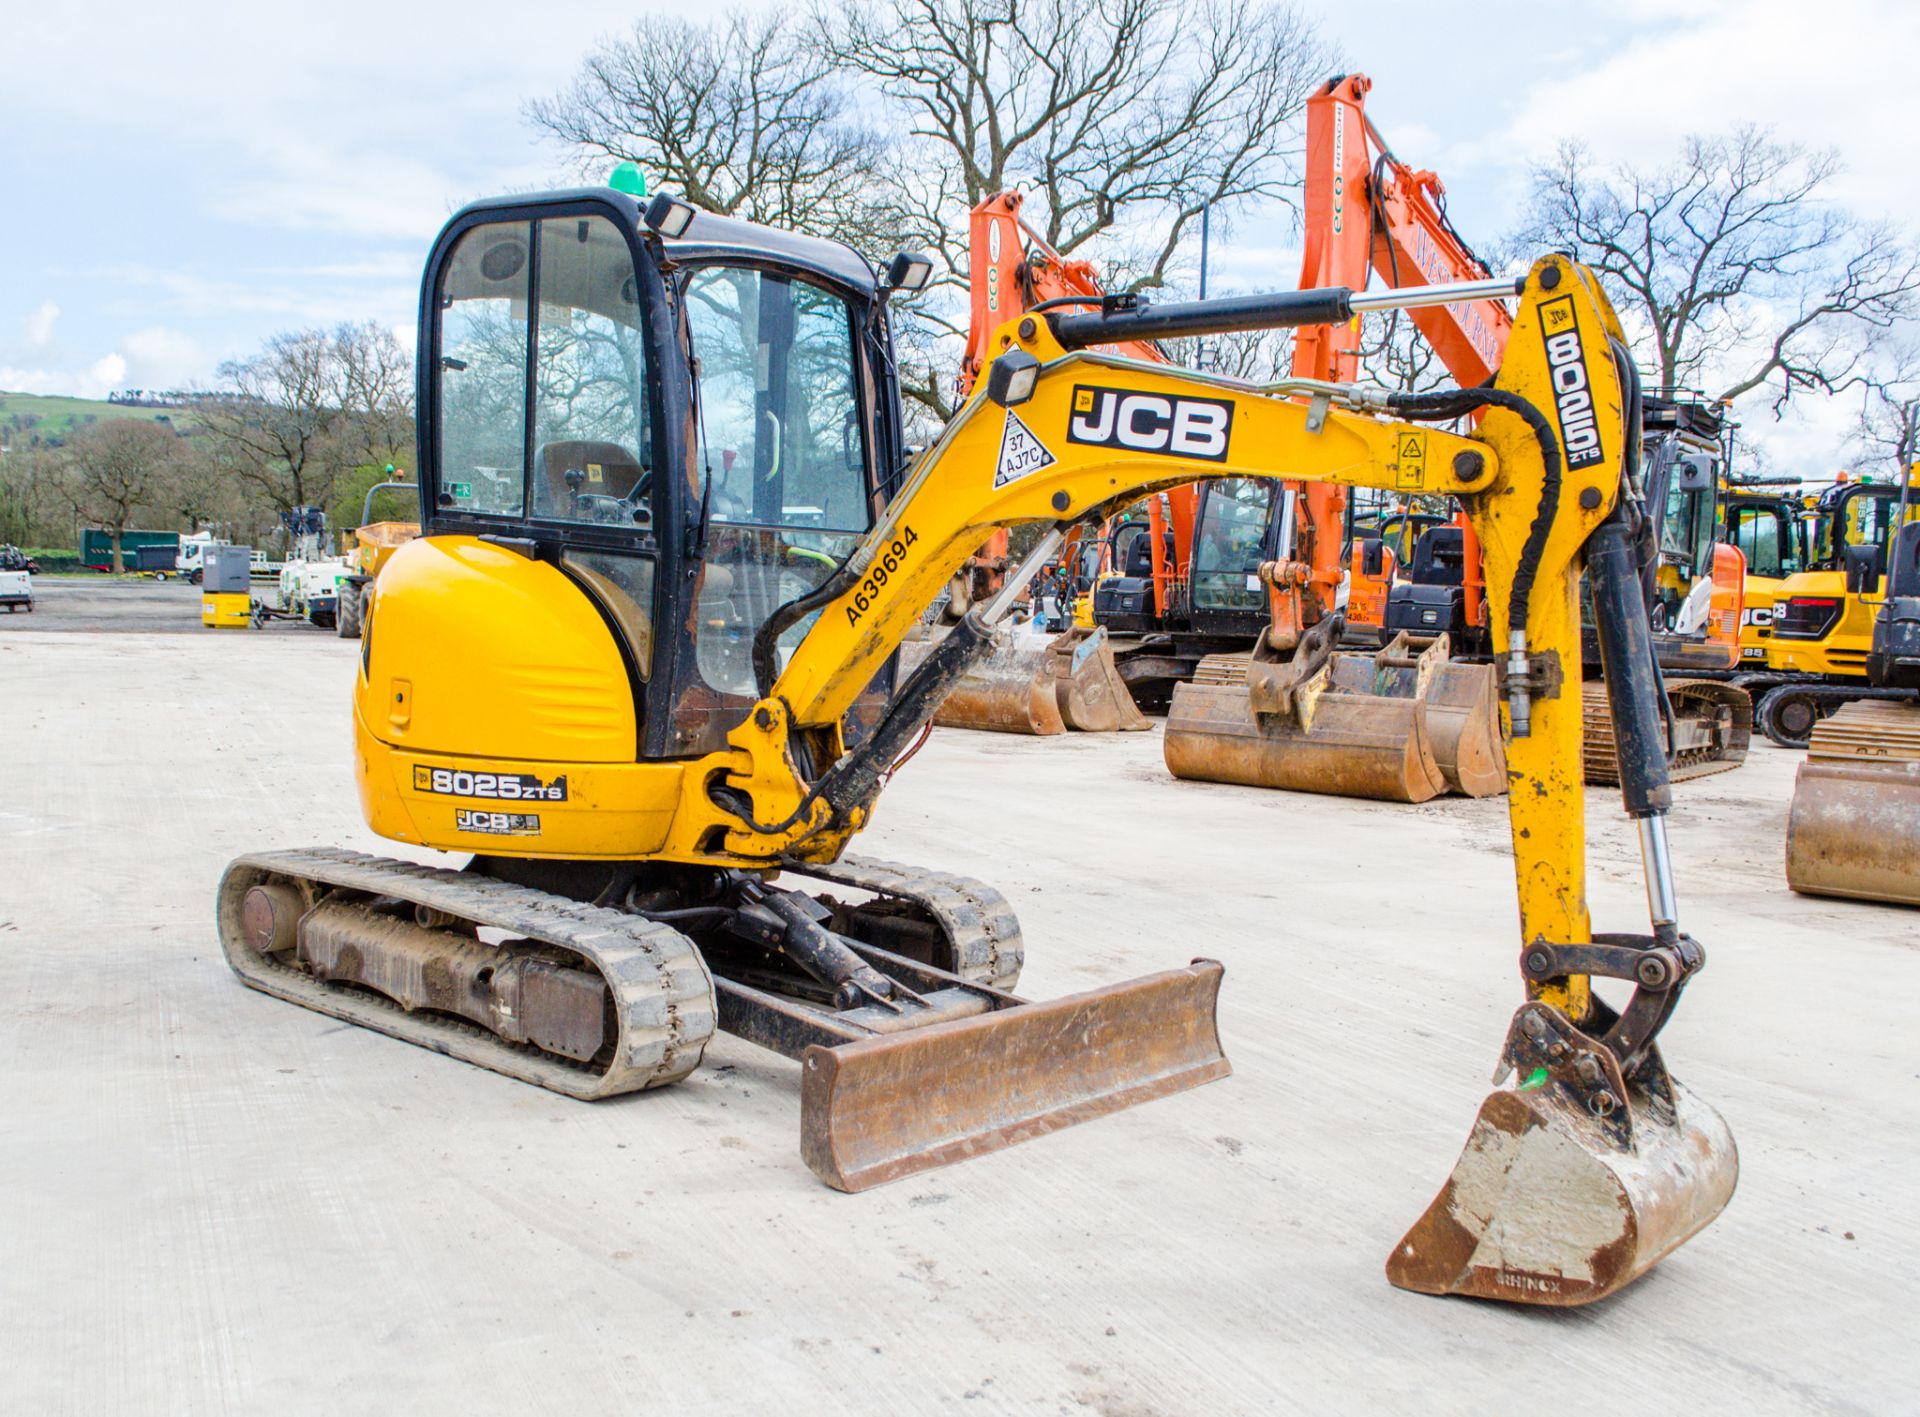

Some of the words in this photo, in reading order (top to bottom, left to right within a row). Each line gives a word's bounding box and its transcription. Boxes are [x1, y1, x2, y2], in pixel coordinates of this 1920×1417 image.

[1547, 332, 1598, 452] 8025
[1072, 392, 1228, 456] JCB
[1009, 433, 1024, 452] 37
[1569, 447, 1601, 463] ZTS
[1006, 447, 1040, 474] AJ7C
[846, 525, 919, 628] A639694
[1743, 608, 1772, 626] JC
[432, 769, 522, 799] 8025
[522, 786, 562, 800] ZTS
[458, 810, 509, 830] JCB
